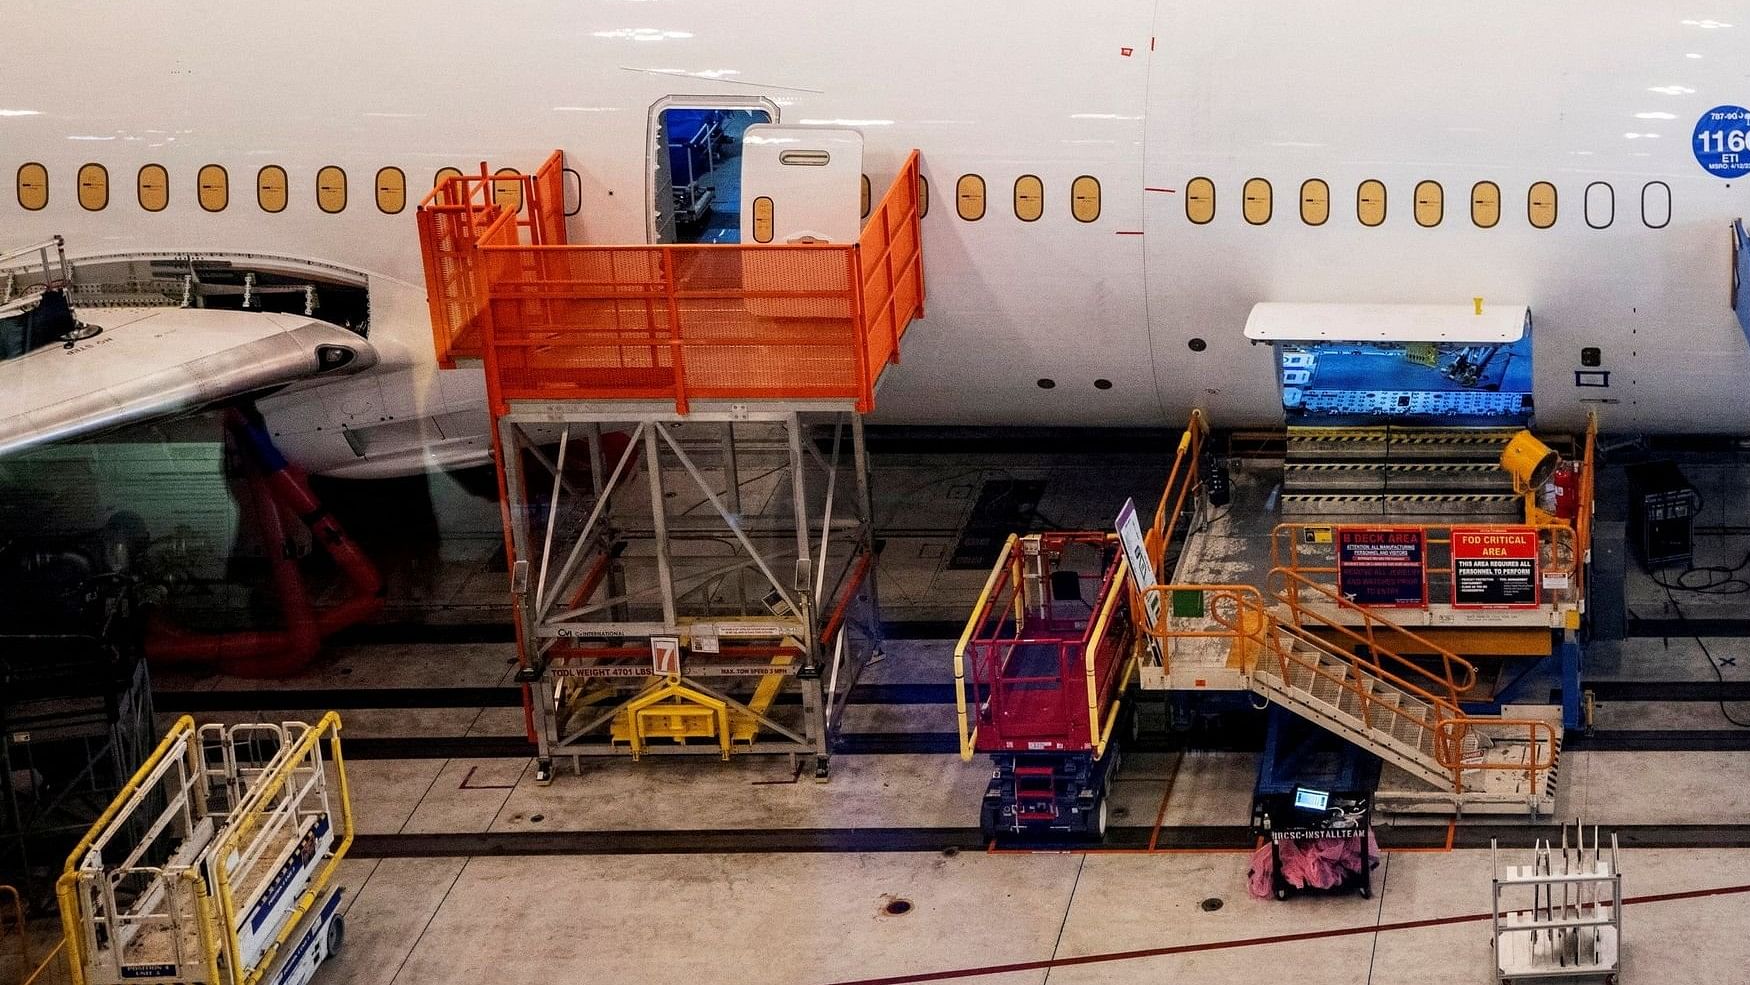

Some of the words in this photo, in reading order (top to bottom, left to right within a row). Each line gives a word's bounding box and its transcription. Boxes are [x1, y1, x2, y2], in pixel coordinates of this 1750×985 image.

[1721, 153, 1739, 163] ETI
[1354, 533, 1385, 543] DECK
[1388, 533, 1419, 543] AREA
[1462, 535, 1481, 545] FOD
[1483, 535, 1527, 545] CRITICAL
[1482, 547, 1508, 556] AREA
[1458, 560, 1473, 568] THIS
[1473, 560, 1490, 568] AREA
[1490, 560, 1519, 568] REQUIRES
[1520, 560, 1532, 568] ALL
[1458, 568, 1493, 576] PERSONNEL
[1493, 568, 1502, 576] TO
[1502, 568, 1531, 576] PERFORM
[656, 641, 675, 673] 7
[551, 668, 576, 678] TOOL
[576, 668, 611, 677] WEIGHT
[612, 668, 633, 677] 4701
